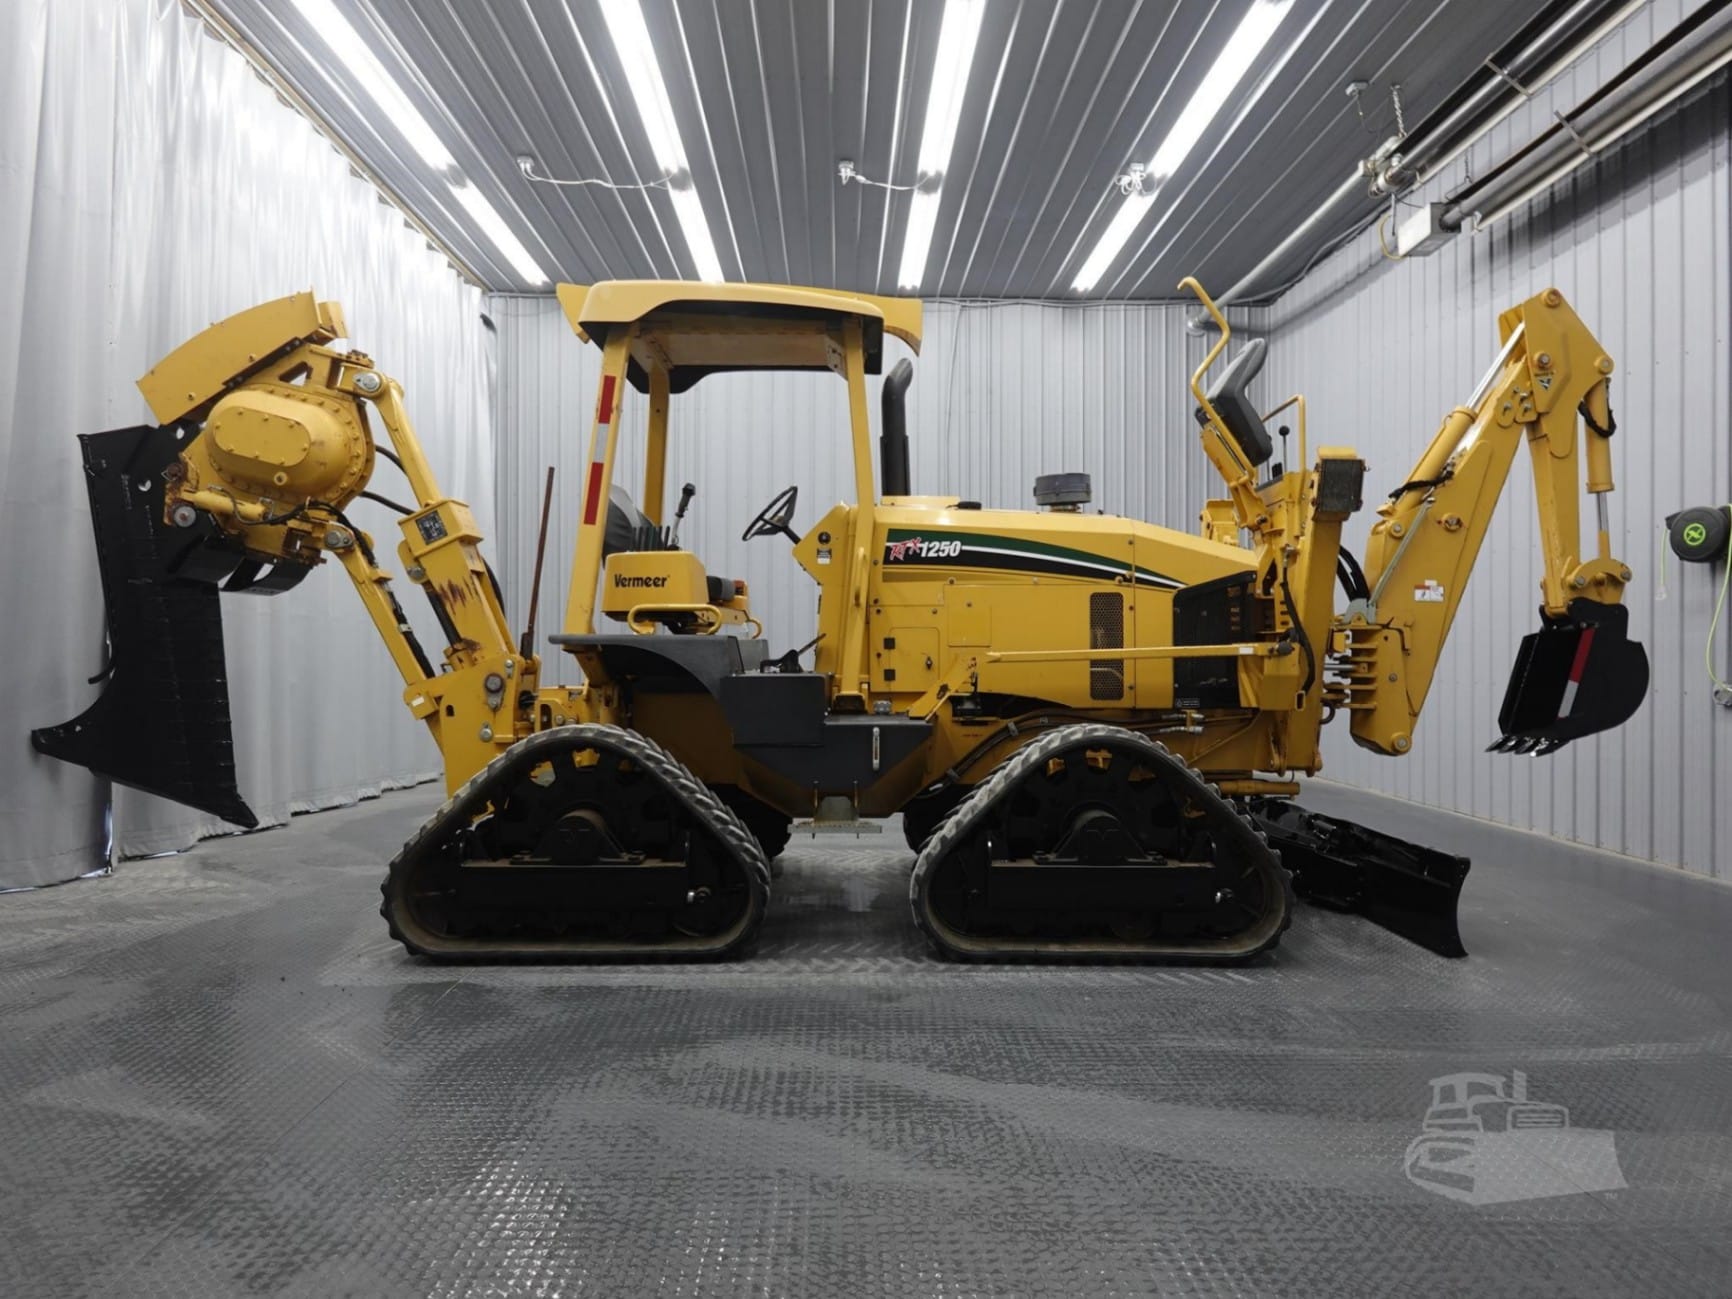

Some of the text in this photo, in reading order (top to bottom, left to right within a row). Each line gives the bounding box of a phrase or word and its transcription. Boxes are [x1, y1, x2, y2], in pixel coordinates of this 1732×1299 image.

[889, 537, 961, 561] RTX 1250
[614, 573, 668, 588] Vermeer
